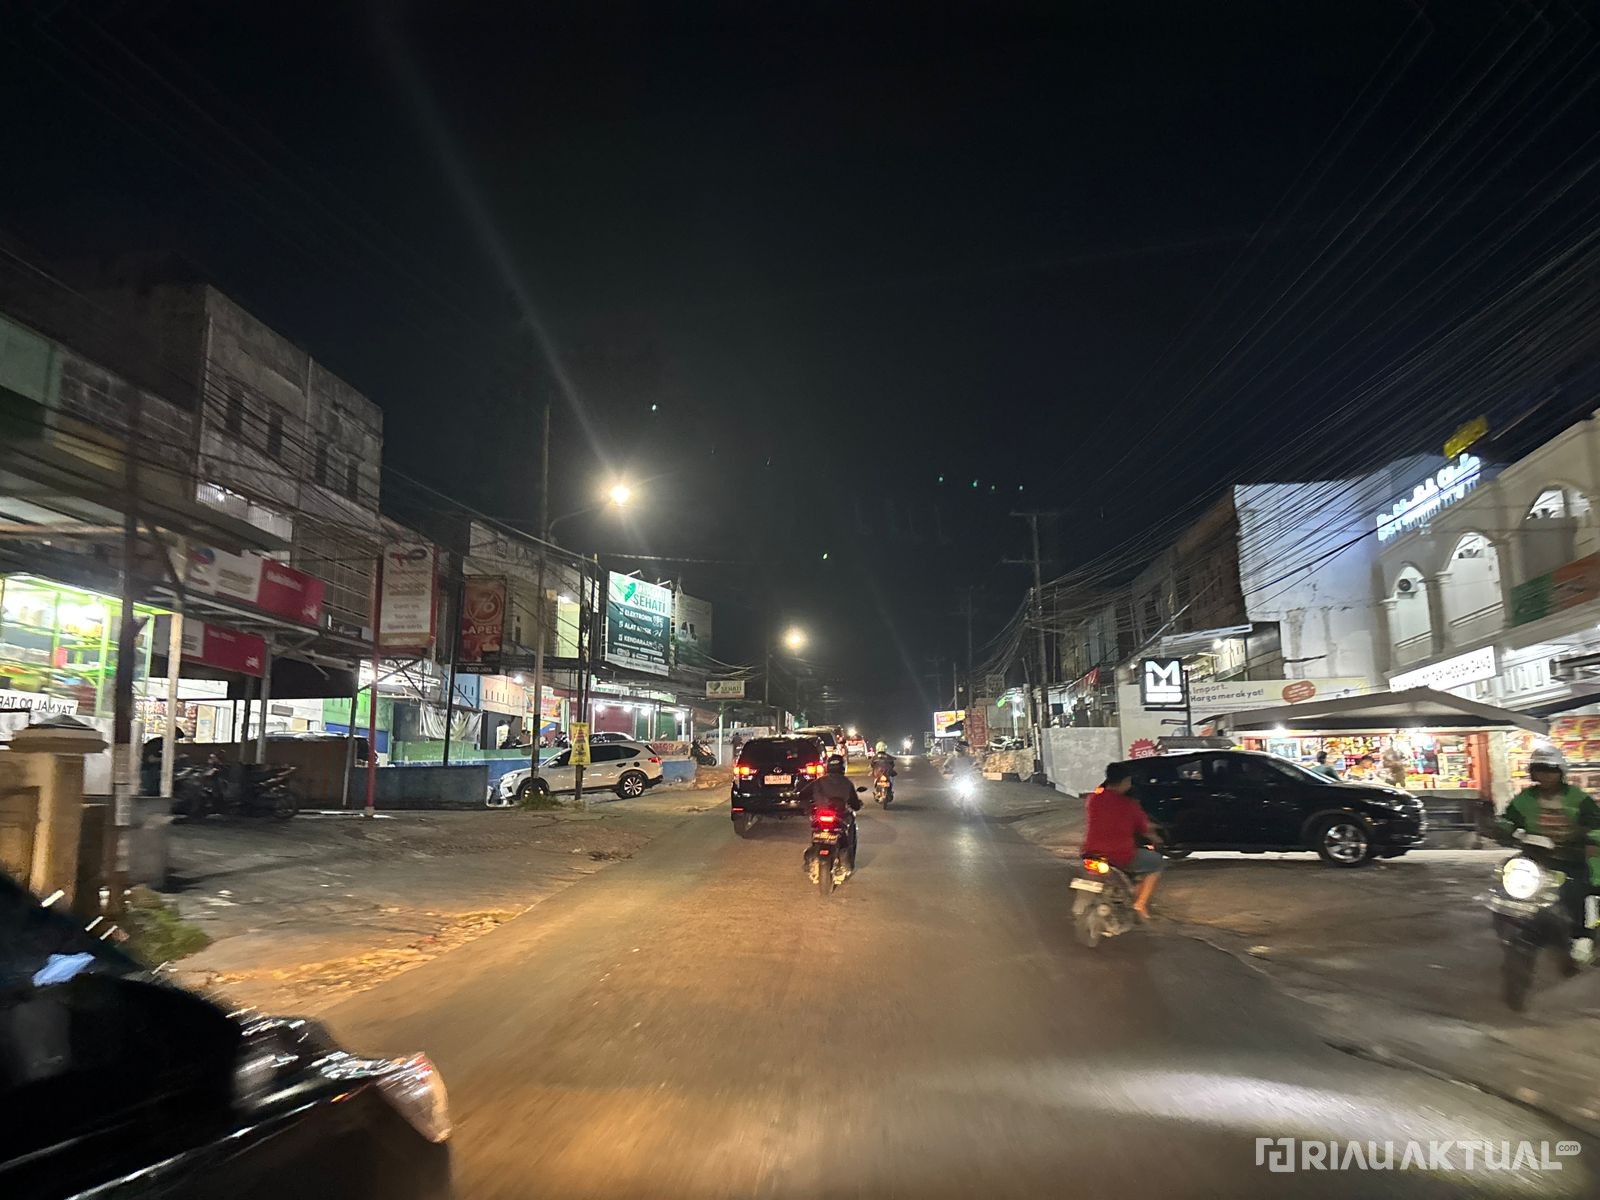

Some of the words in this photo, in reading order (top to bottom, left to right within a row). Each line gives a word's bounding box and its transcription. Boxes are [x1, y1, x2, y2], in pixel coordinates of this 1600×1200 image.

[633, 593, 666, 613] SEHATI
[468, 625, 500, 634] APEL
[1190, 692, 1217, 703] Harga
